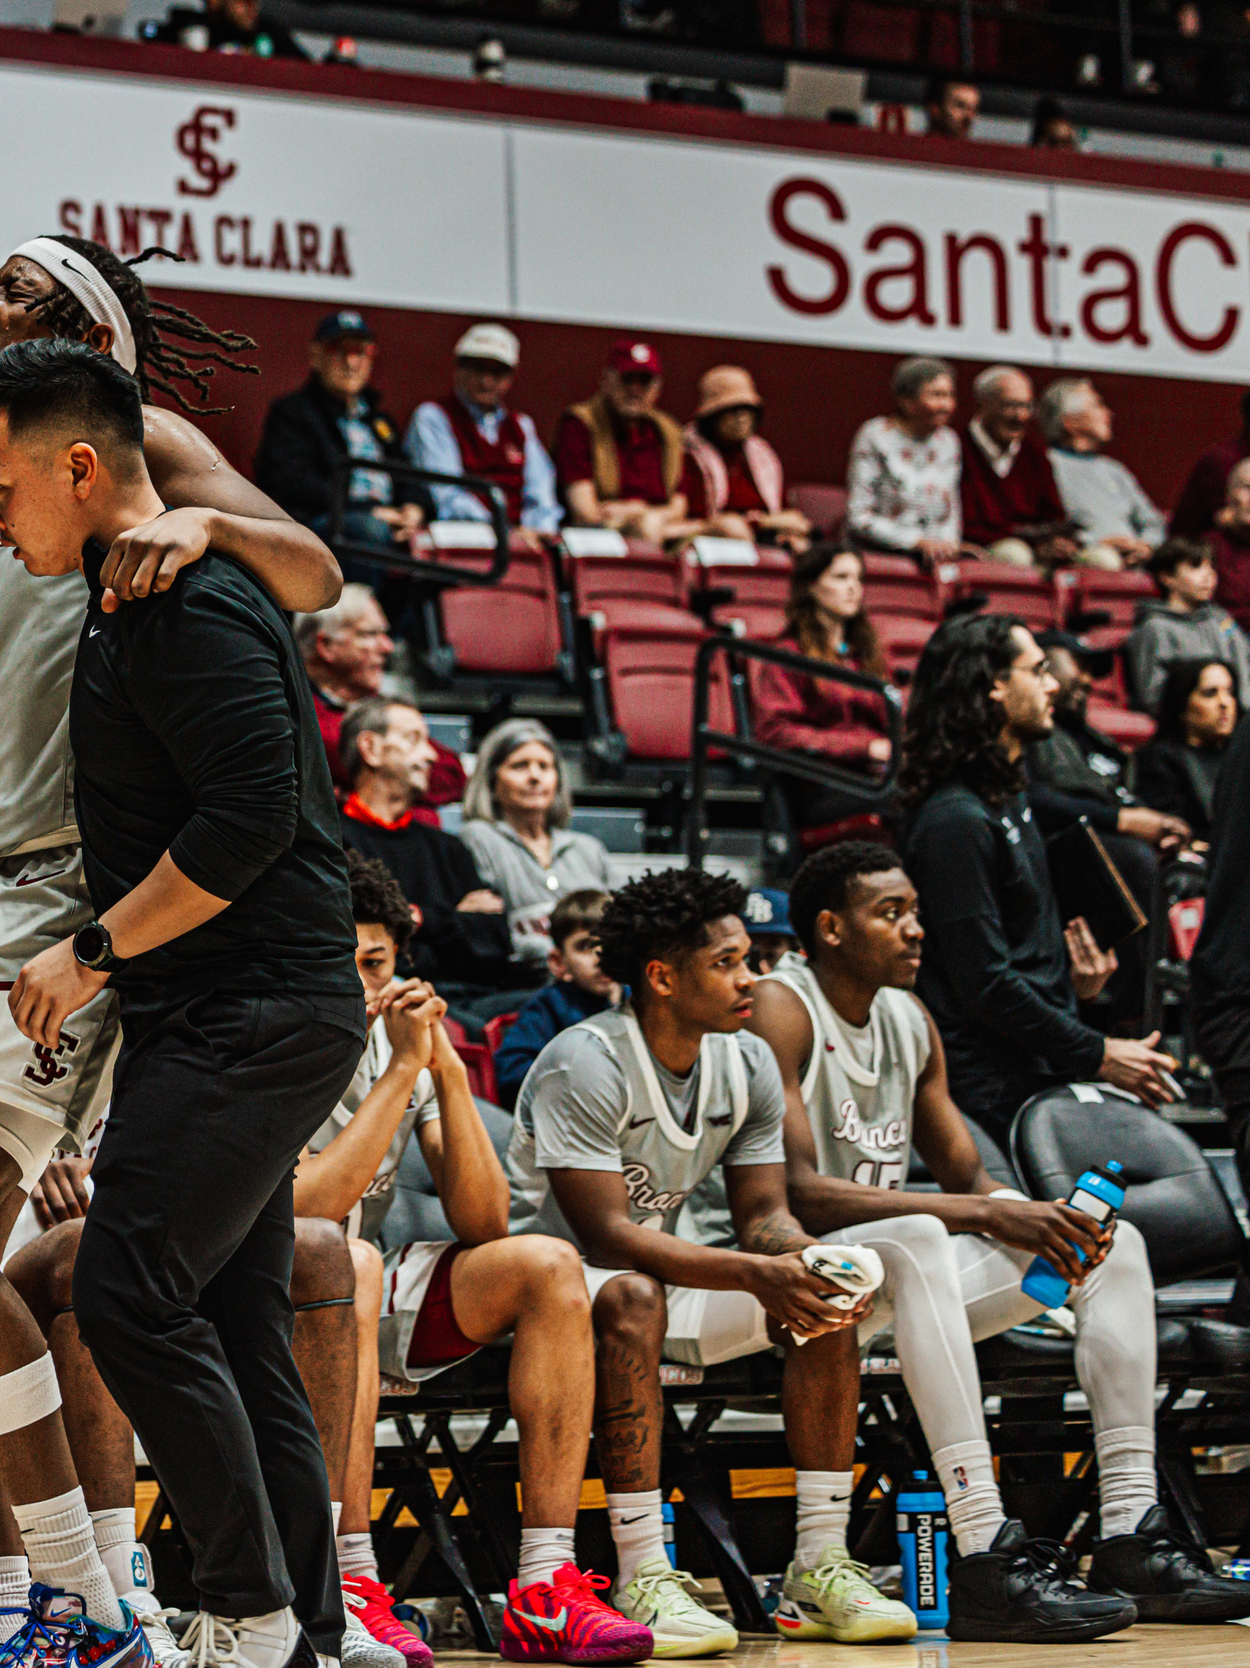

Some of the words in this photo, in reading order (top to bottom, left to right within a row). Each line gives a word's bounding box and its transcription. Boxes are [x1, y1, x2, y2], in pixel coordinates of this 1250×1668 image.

[59, 200, 200, 263] SANTA
[214, 214, 352, 277] CLARA
[916, 1514, 935, 1606] POWERADE
